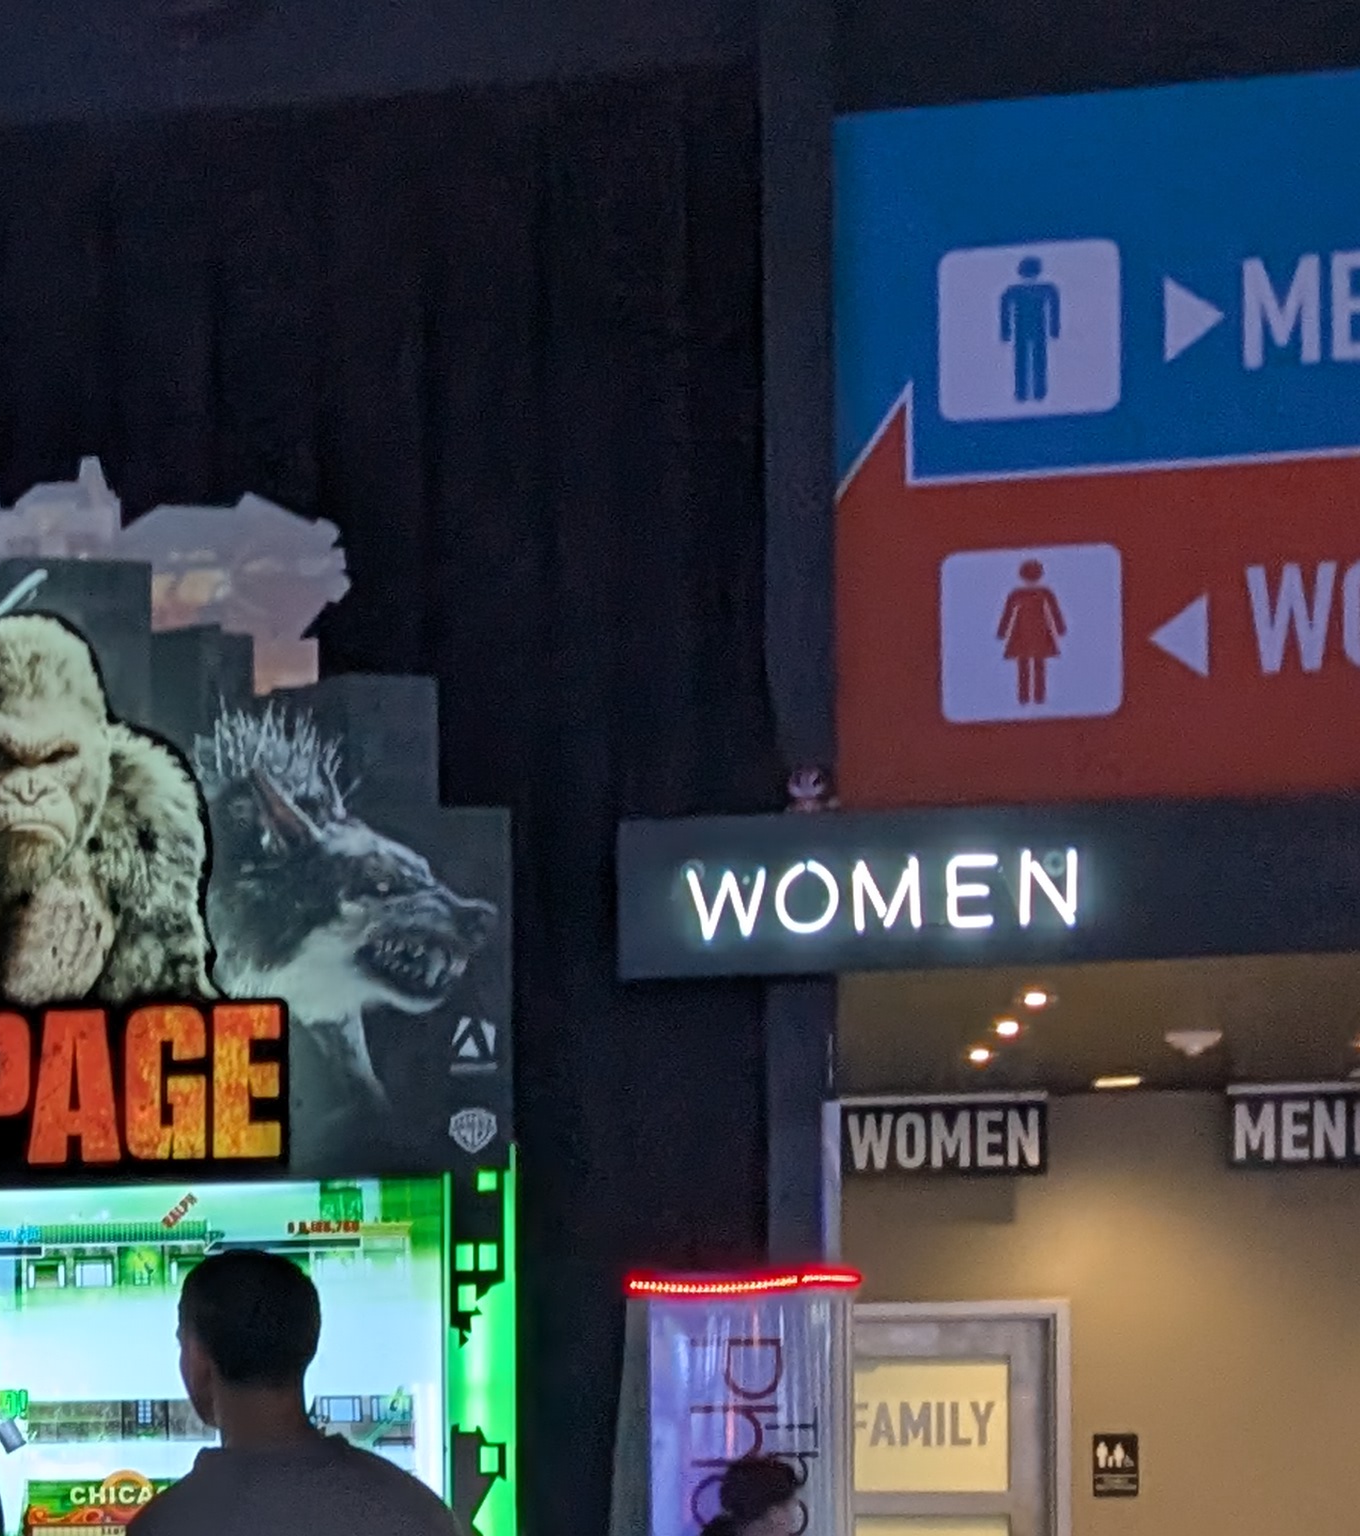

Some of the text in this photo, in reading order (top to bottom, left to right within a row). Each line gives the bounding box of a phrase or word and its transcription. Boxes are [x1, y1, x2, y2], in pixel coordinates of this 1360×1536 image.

[686, 847, 1079, 941] WOMEN
[847, 1108, 1040, 1169] WOMEN
[854, 1401, 995, 1446] FAMILY
